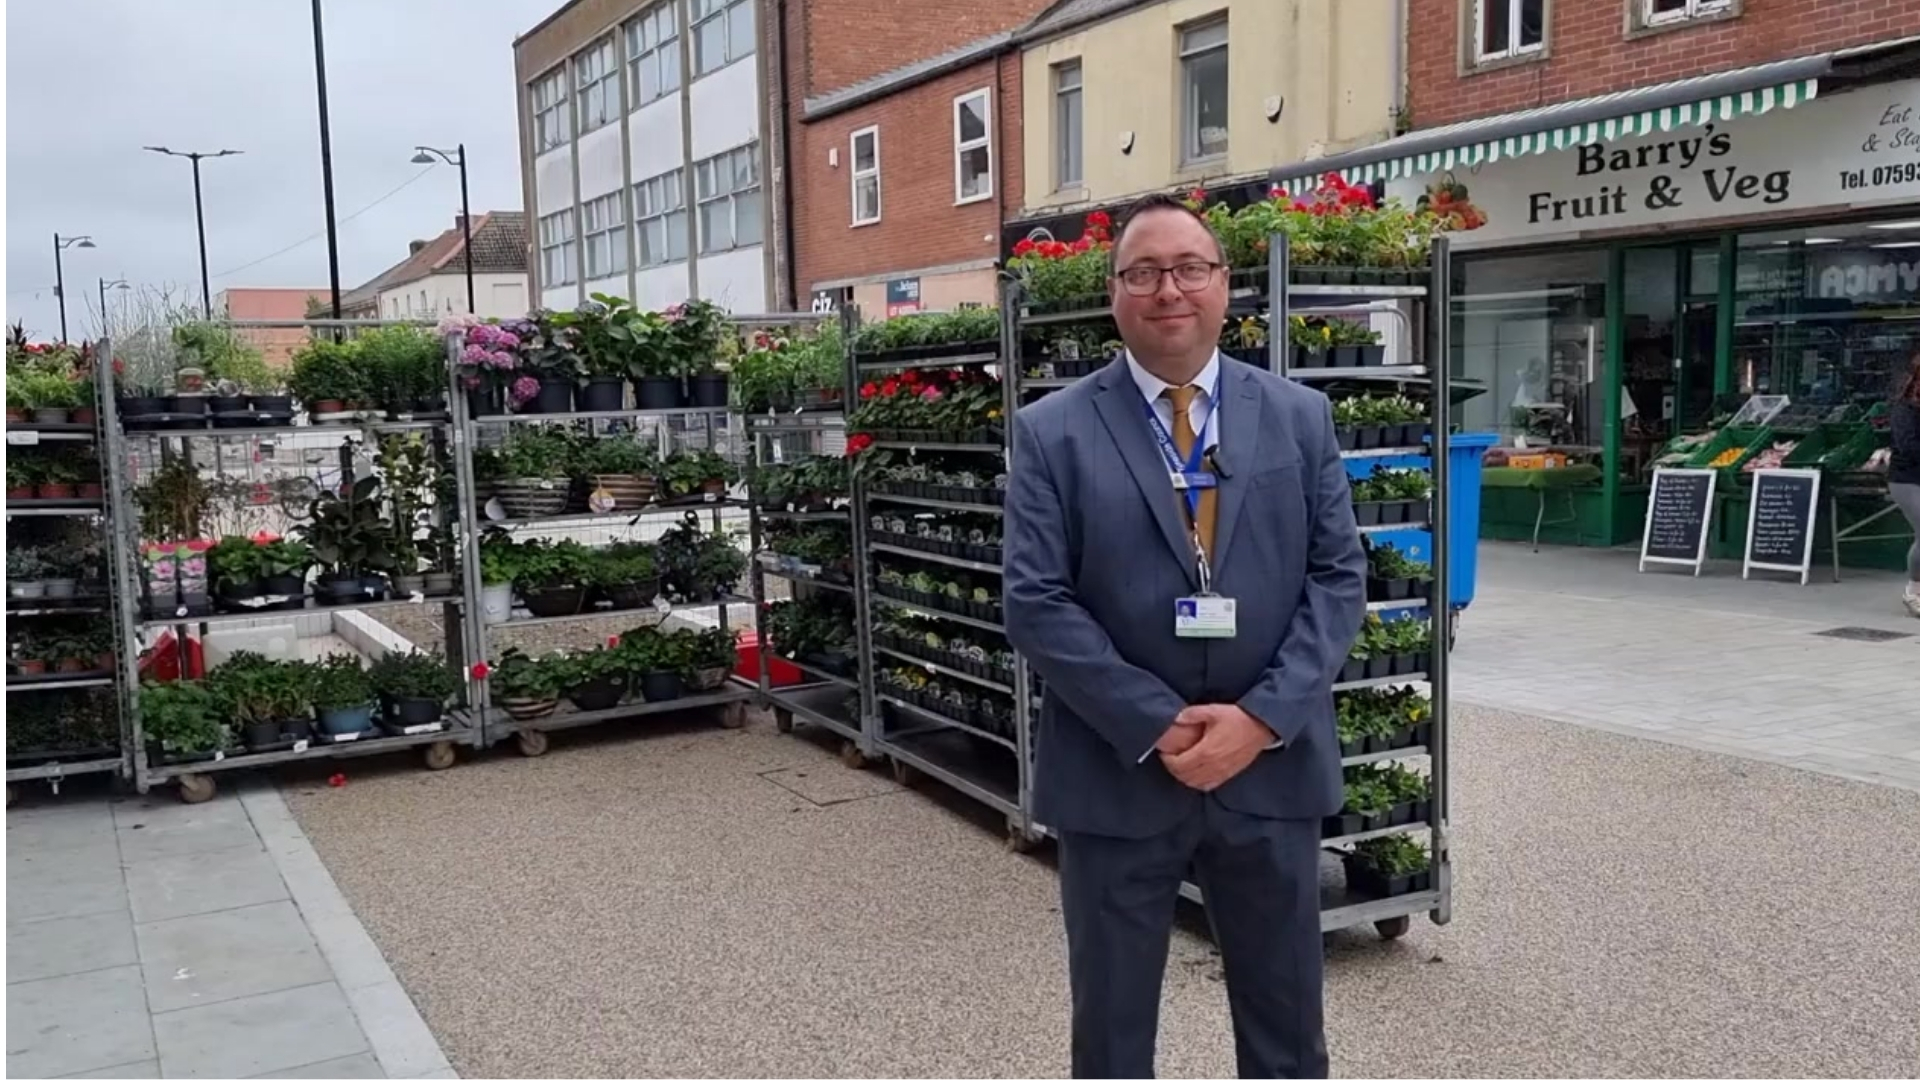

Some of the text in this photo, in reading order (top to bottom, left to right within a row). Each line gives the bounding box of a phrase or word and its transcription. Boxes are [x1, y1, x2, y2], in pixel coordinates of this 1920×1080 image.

[1879, 103, 1912, 126] Eat
[1577, 122, 1732, 175] Barry's
[1861, 133, 1882, 152] &
[1840, 168, 1868, 190] Tel.
[1528, 166, 1792, 224] Fruit & Veg
